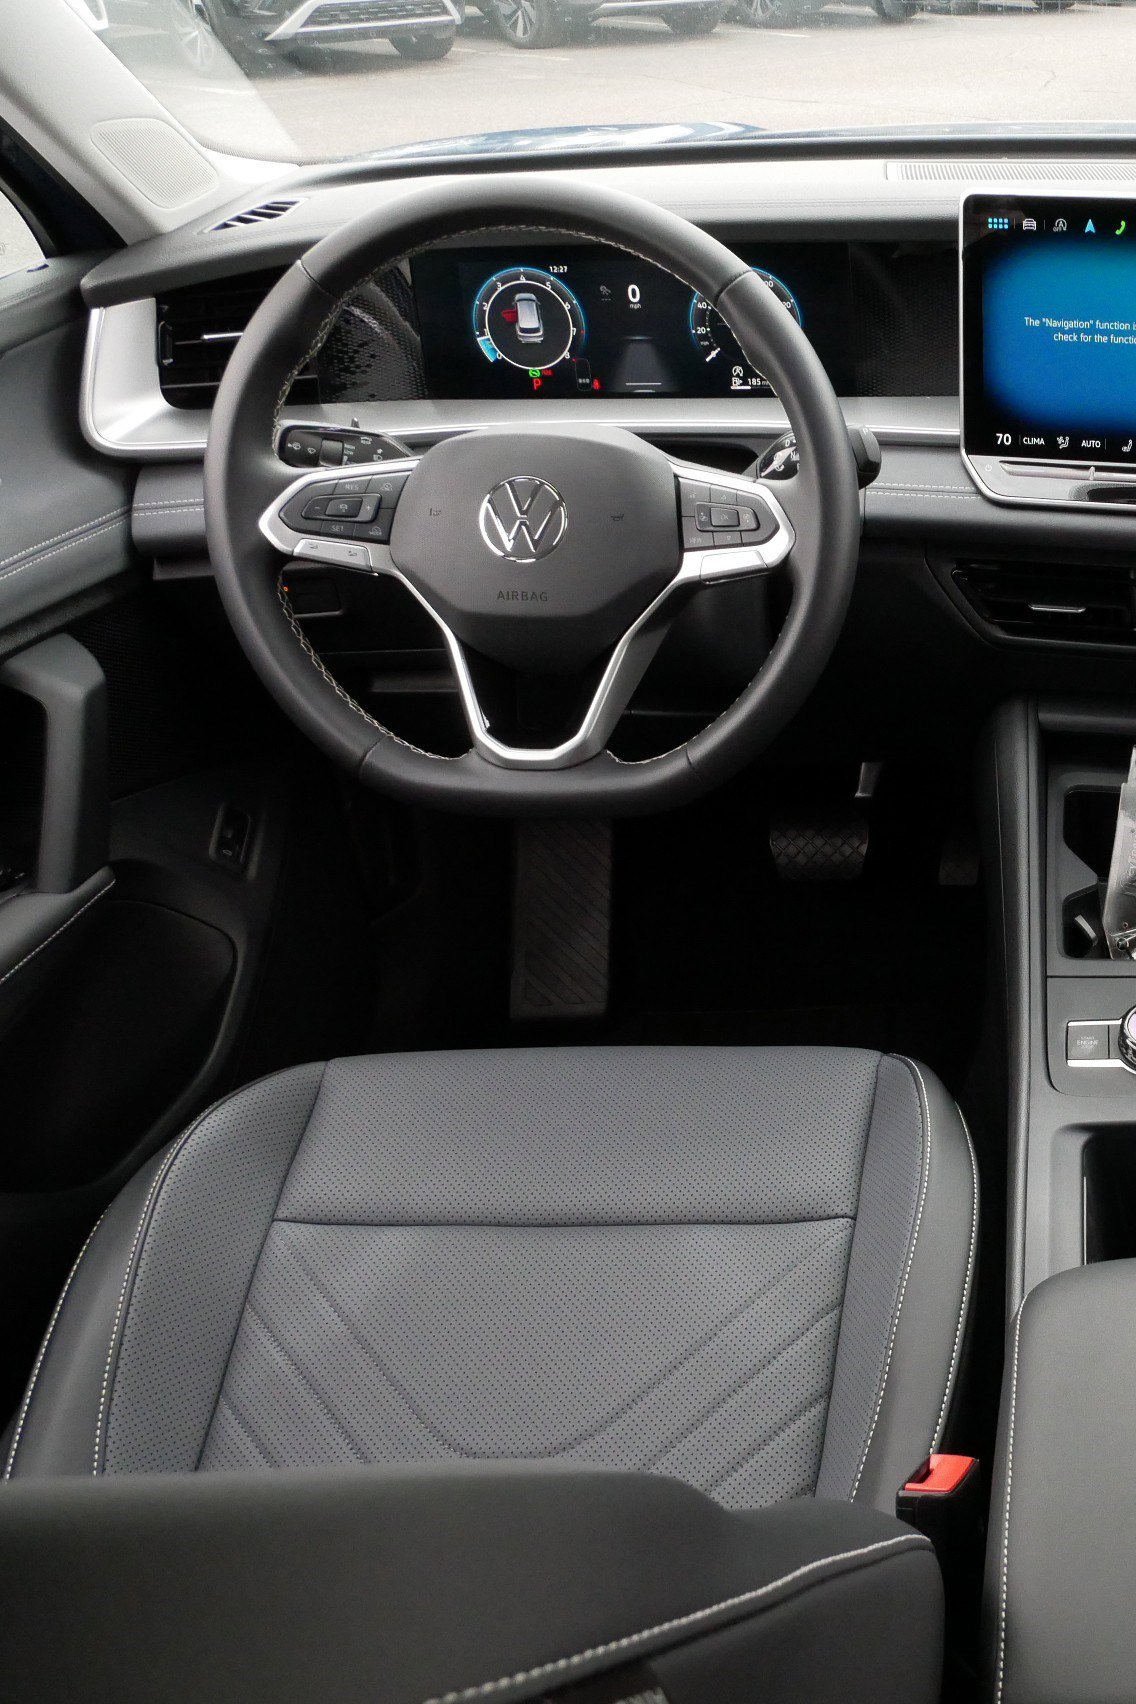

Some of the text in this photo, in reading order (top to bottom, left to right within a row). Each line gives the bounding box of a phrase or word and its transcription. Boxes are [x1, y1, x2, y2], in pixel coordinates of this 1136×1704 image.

[628, 284, 640, 302] 0
[1024, 317, 1040, 326] The
[1042, 318, 1094, 330] "Navigation"
[1096, 320, 1130, 330] function
[1054, 333, 1078, 342] check
[1080, 333, 1092, 342] for
[1094, 334, 1108, 343] the
[532, 378, 542, 390] P
[996, 434, 1012, 445] 70
[497, 590, 548, 602] AIRBAG
